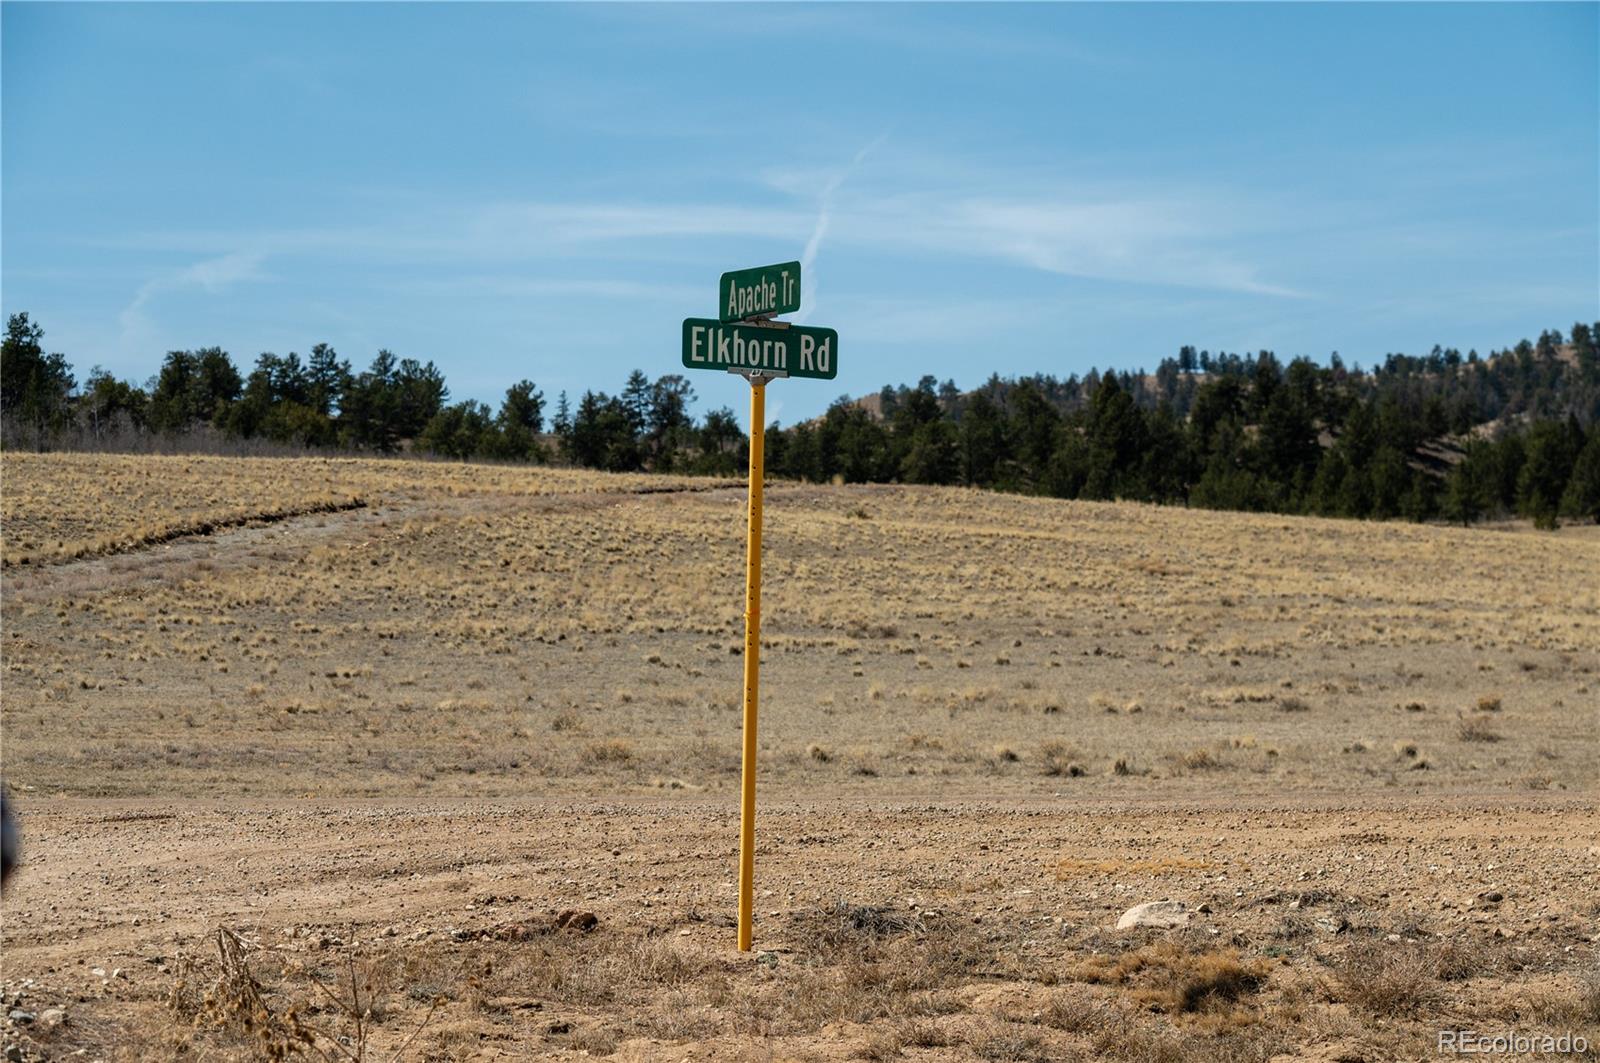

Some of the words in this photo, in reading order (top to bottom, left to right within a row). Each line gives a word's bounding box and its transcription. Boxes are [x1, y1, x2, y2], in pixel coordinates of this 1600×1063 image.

[728, 275, 776, 318] Apache
[781, 270, 794, 306] Tr
[691, 326, 787, 368] Elkhorn
[800, 334, 830, 372] Rd
